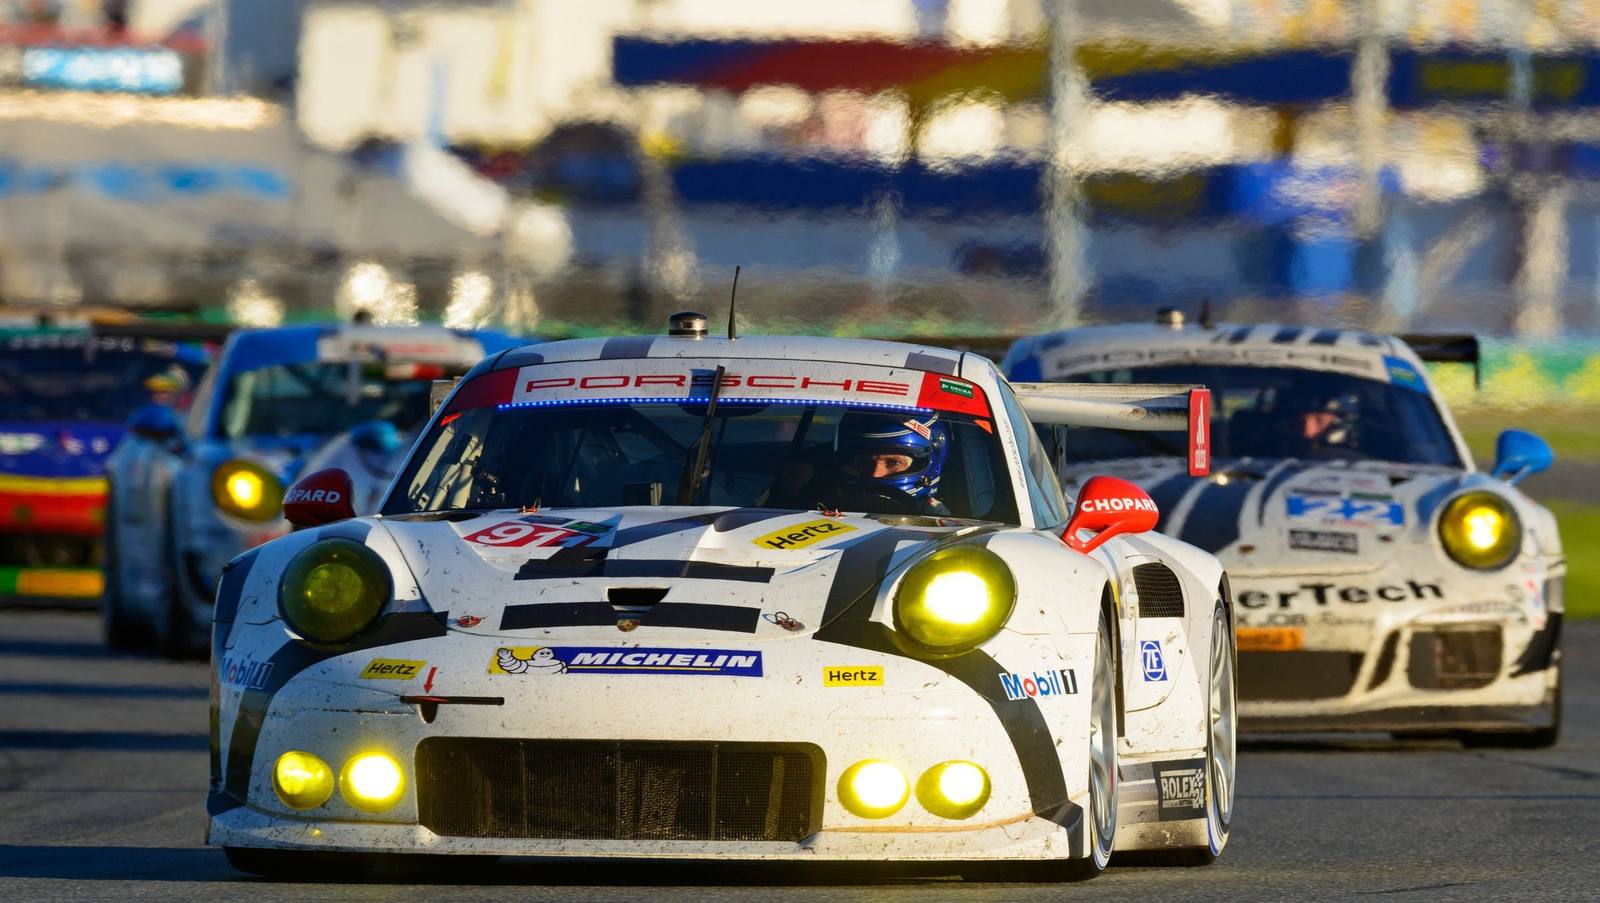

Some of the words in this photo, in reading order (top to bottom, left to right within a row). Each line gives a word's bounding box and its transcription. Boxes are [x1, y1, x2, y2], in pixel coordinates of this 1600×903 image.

[525, 374, 909, 396] PORSCHE
[1080, 498, 1158, 513] CHOPARD
[1302, 498, 1391, 523] 22
[766, 518, 844, 550] Hertz
[1238, 580, 1444, 608] erTech
[222, 656, 255, 687] Mobil
[368, 662, 416, 675] Hertz
[569, 652, 757, 668] MICHELIN
[829, 669, 878, 682] Hertz
[1000, 670, 1061, 699] Mobil
[1061, 669, 1077, 695] 1
[1161, 776, 1195, 799] ROLEX
